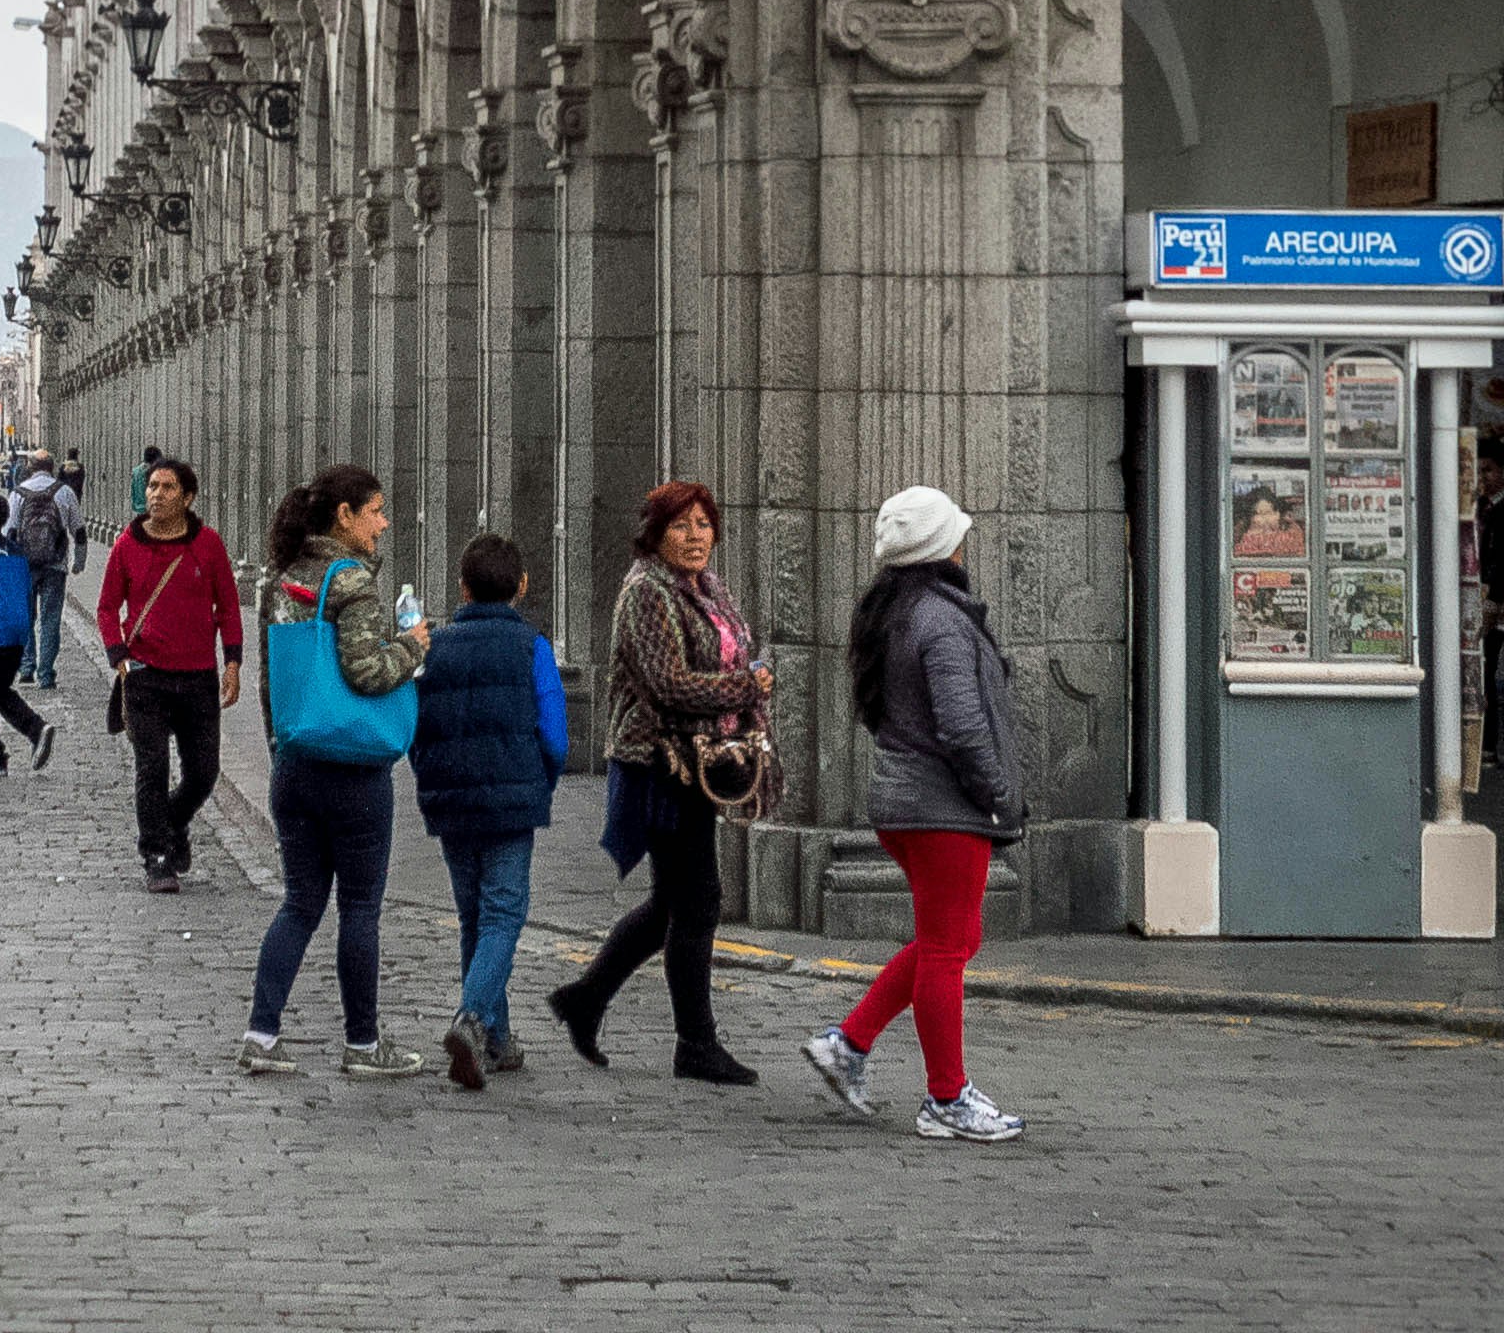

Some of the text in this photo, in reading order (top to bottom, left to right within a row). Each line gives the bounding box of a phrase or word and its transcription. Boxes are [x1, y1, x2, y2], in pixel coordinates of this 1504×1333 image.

[1163, 223, 1222, 249] Perú
[1265, 231, 1397, 254] AREQUIPA
[1194, 247, 1222, 267] 21
[1242, 255, 1420, 268] Patrimonio Cultural de la Humanidad
